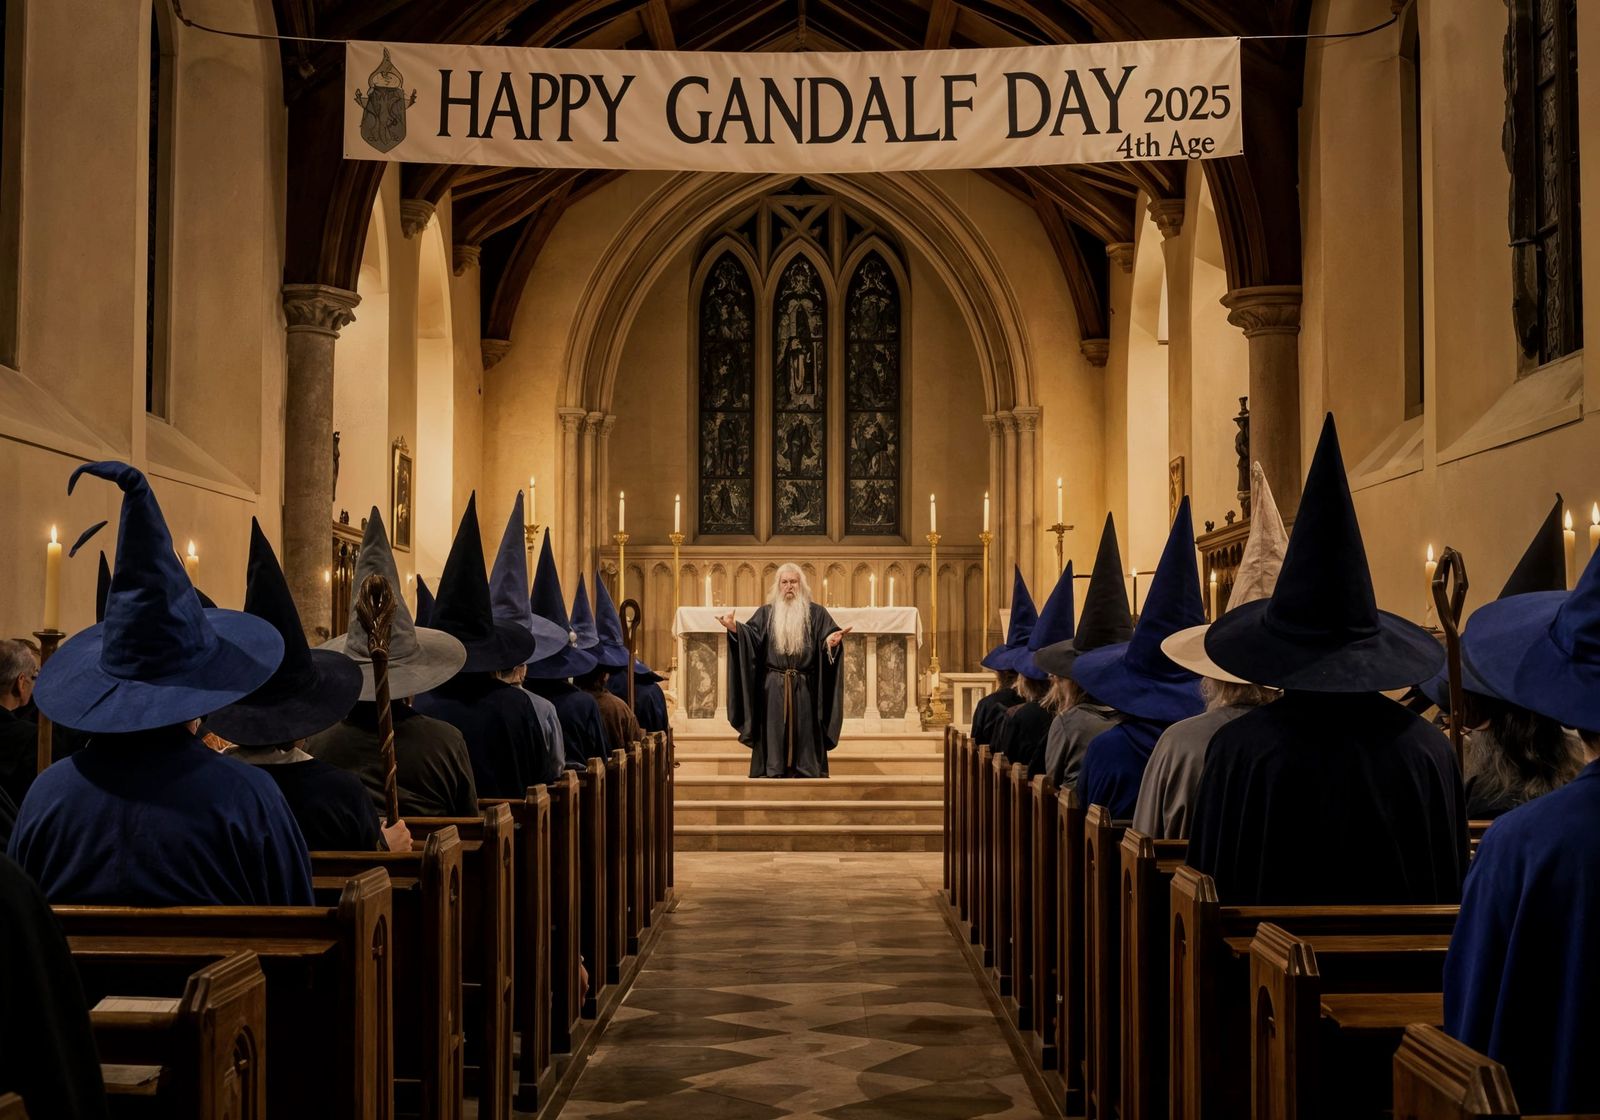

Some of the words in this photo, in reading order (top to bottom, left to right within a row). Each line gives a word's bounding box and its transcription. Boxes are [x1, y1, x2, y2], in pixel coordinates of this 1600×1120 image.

[437, 69, 636, 142] HAPPY
[666, 73, 978, 144] GANDALF
[1003, 65, 1138, 139] DAY
[1144, 85, 1231, 123] 2025
[1116, 132, 1161, 159] 4th
[1168, 129, 1215, 160] Age
